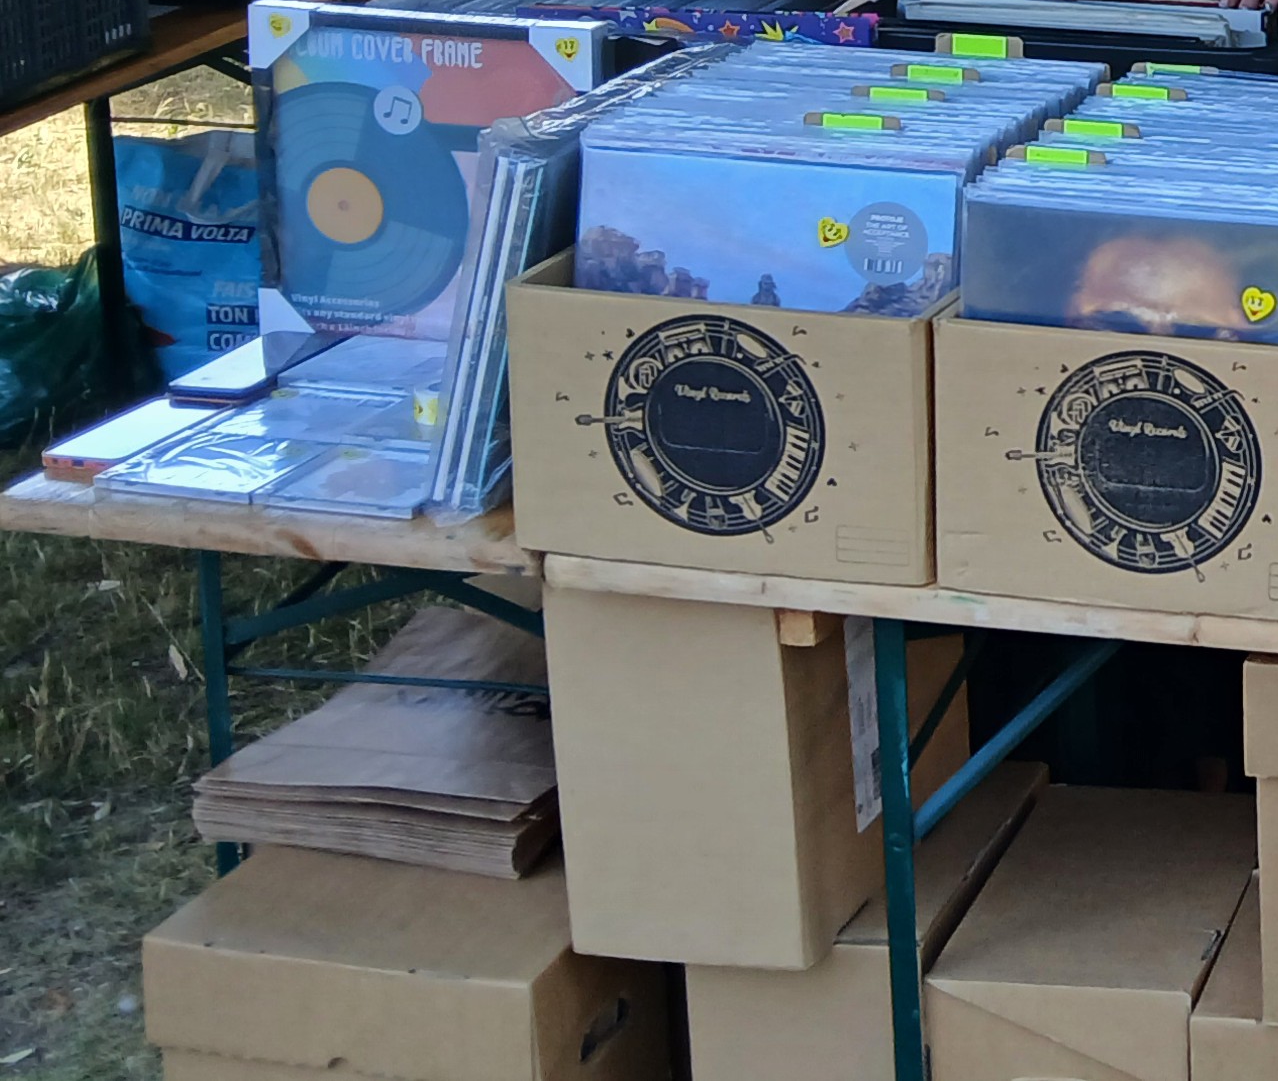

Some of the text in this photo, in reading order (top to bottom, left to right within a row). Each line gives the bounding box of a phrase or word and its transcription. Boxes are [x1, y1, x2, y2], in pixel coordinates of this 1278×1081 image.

[351, 33, 414, 64] COVER
[421, 38, 483, 69] FRAME
[121, 207, 184, 239] PRIMA
[190, 224, 250, 242] VOLTA
[207, 305, 249, 324] TON
